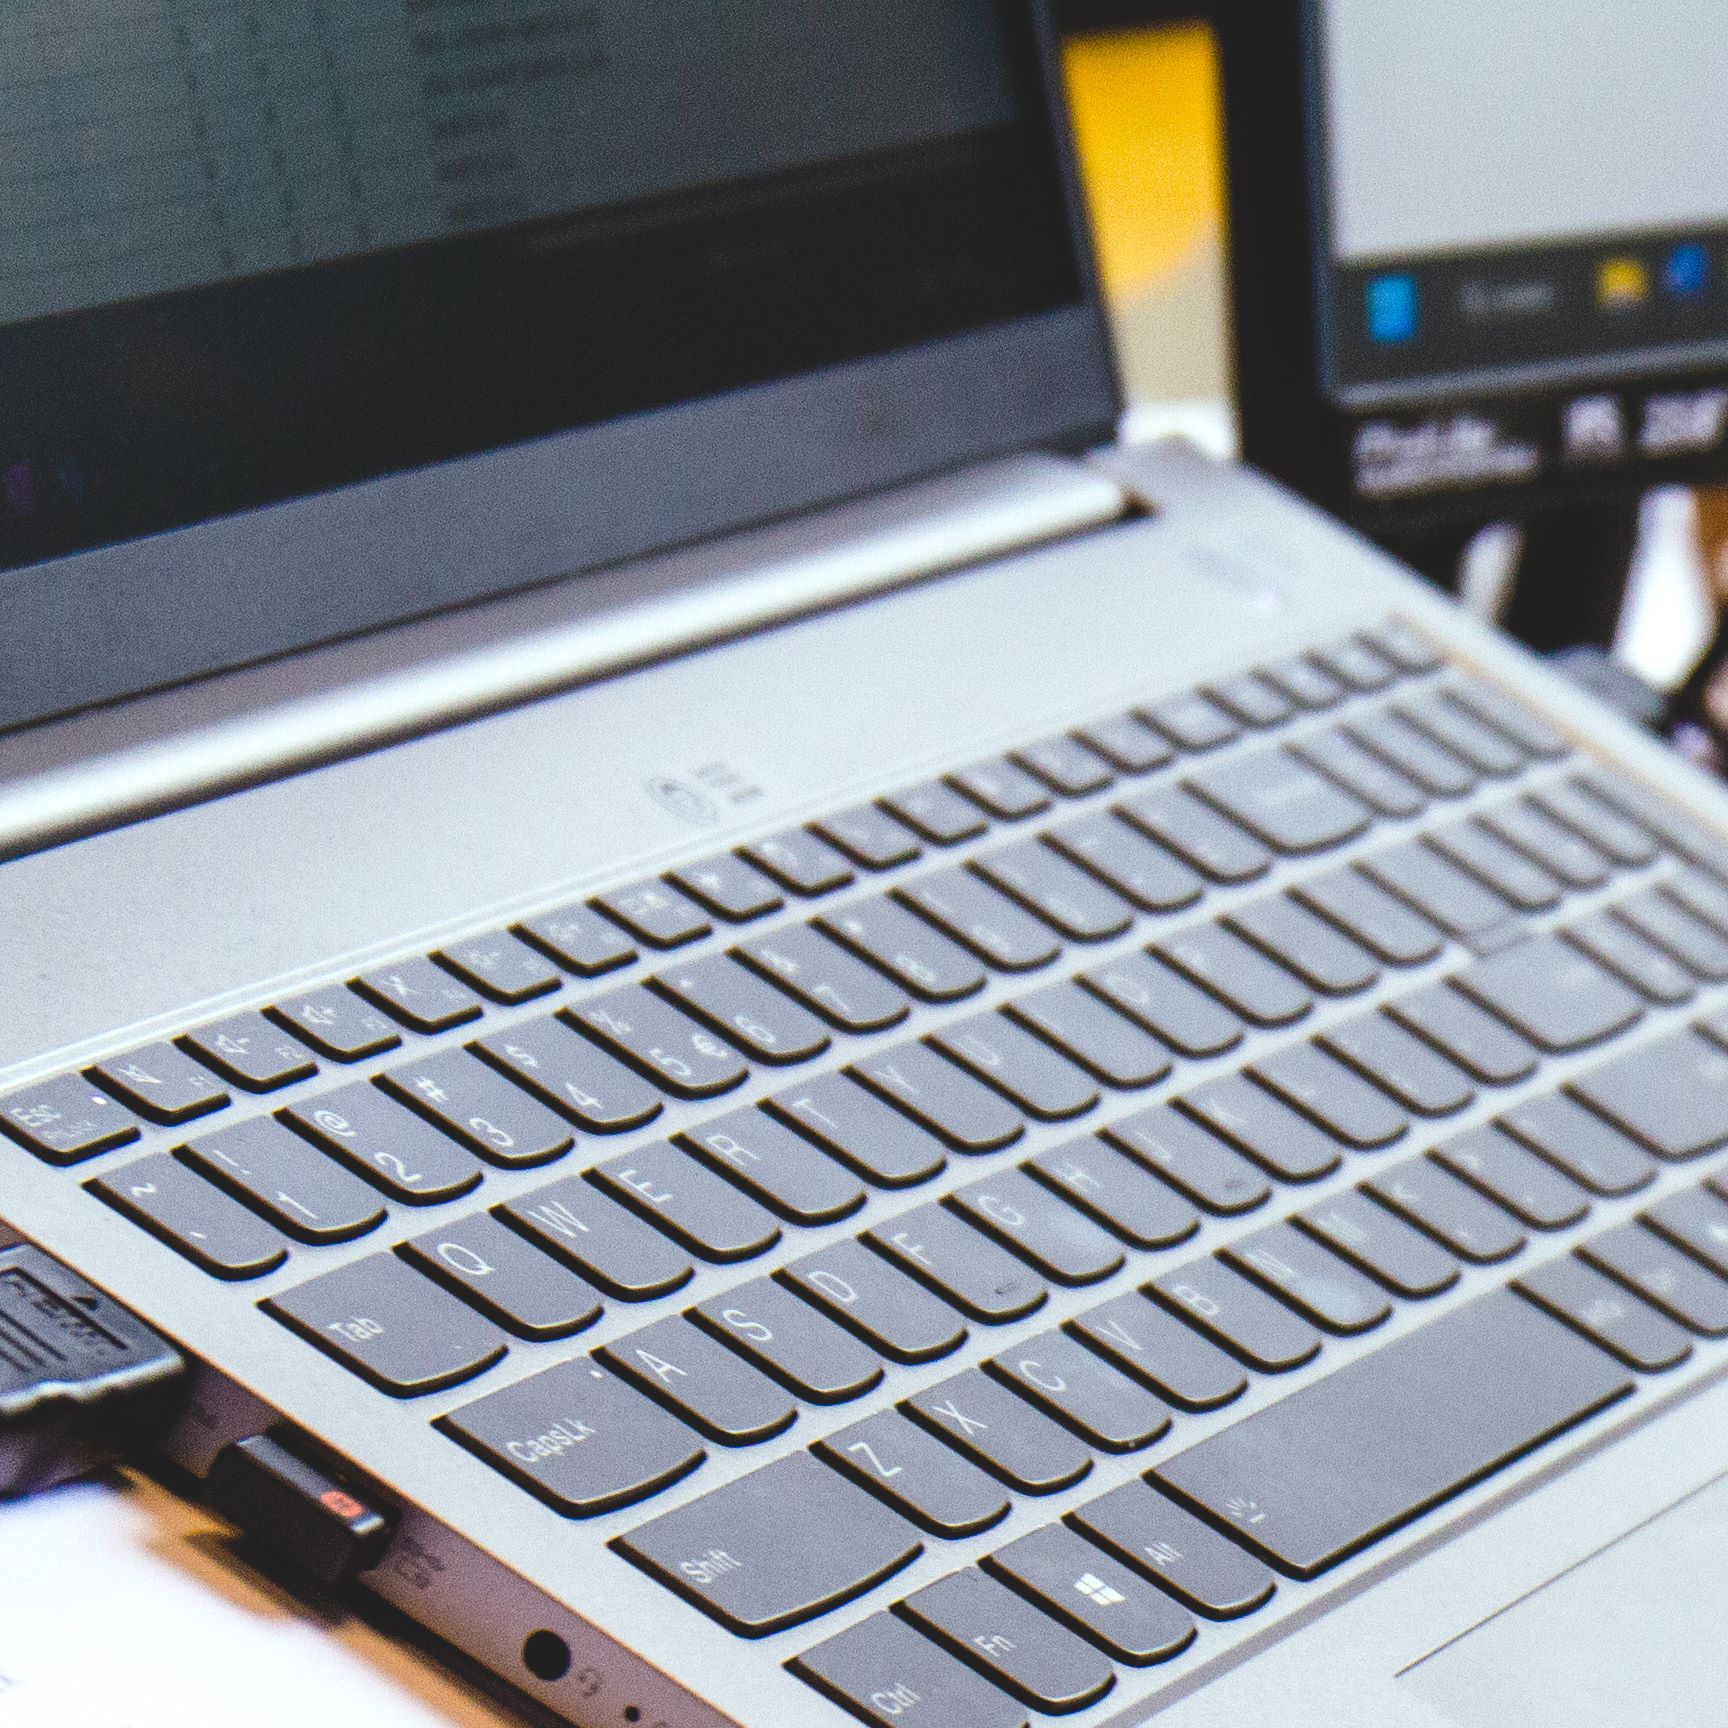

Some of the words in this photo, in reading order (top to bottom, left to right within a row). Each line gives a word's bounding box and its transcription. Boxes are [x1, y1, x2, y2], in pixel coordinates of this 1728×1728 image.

[735, 1015, 777, 1044] 6
[650, 1048, 693, 1077] 5
[565, 1082, 604, 1109] 4
[792, 1098, 840, 1129] T
[469, 1117, 515, 1148] 3
[374, 1151, 423, 1183] 2
[706, 1133, 763, 1167] R
[619, 1169, 674, 1206] E
[277, 1190, 319, 1220] 1
[529, 1202, 591, 1239] W
[976, 1194, 1027, 1227] G
[437, 1242, 496, 1277] Q
[890, 1231, 938, 1267] F
[806, 1270, 860, 1304] D
[1172, 1284, 1221, 1317] B
[329, 1315, 385, 1343] Tab
[722, 1307, 774, 1344] S
[1096, 1316, 1145, 1352] V
[634, 1346, 690, 1385] A
[1015, 1359, 1069, 1394] C
[931, 1399, 987, 1436] X
[505, 1416, 597, 1467] CapsLk
[848, 1441, 903, 1480] Z
[677, 1548, 746, 1585] Shift
[1145, 1542, 1183, 1568] Alt
[976, 1632, 1018, 1661] Fn
[869, 1684, 923, 1718] Ctrl
